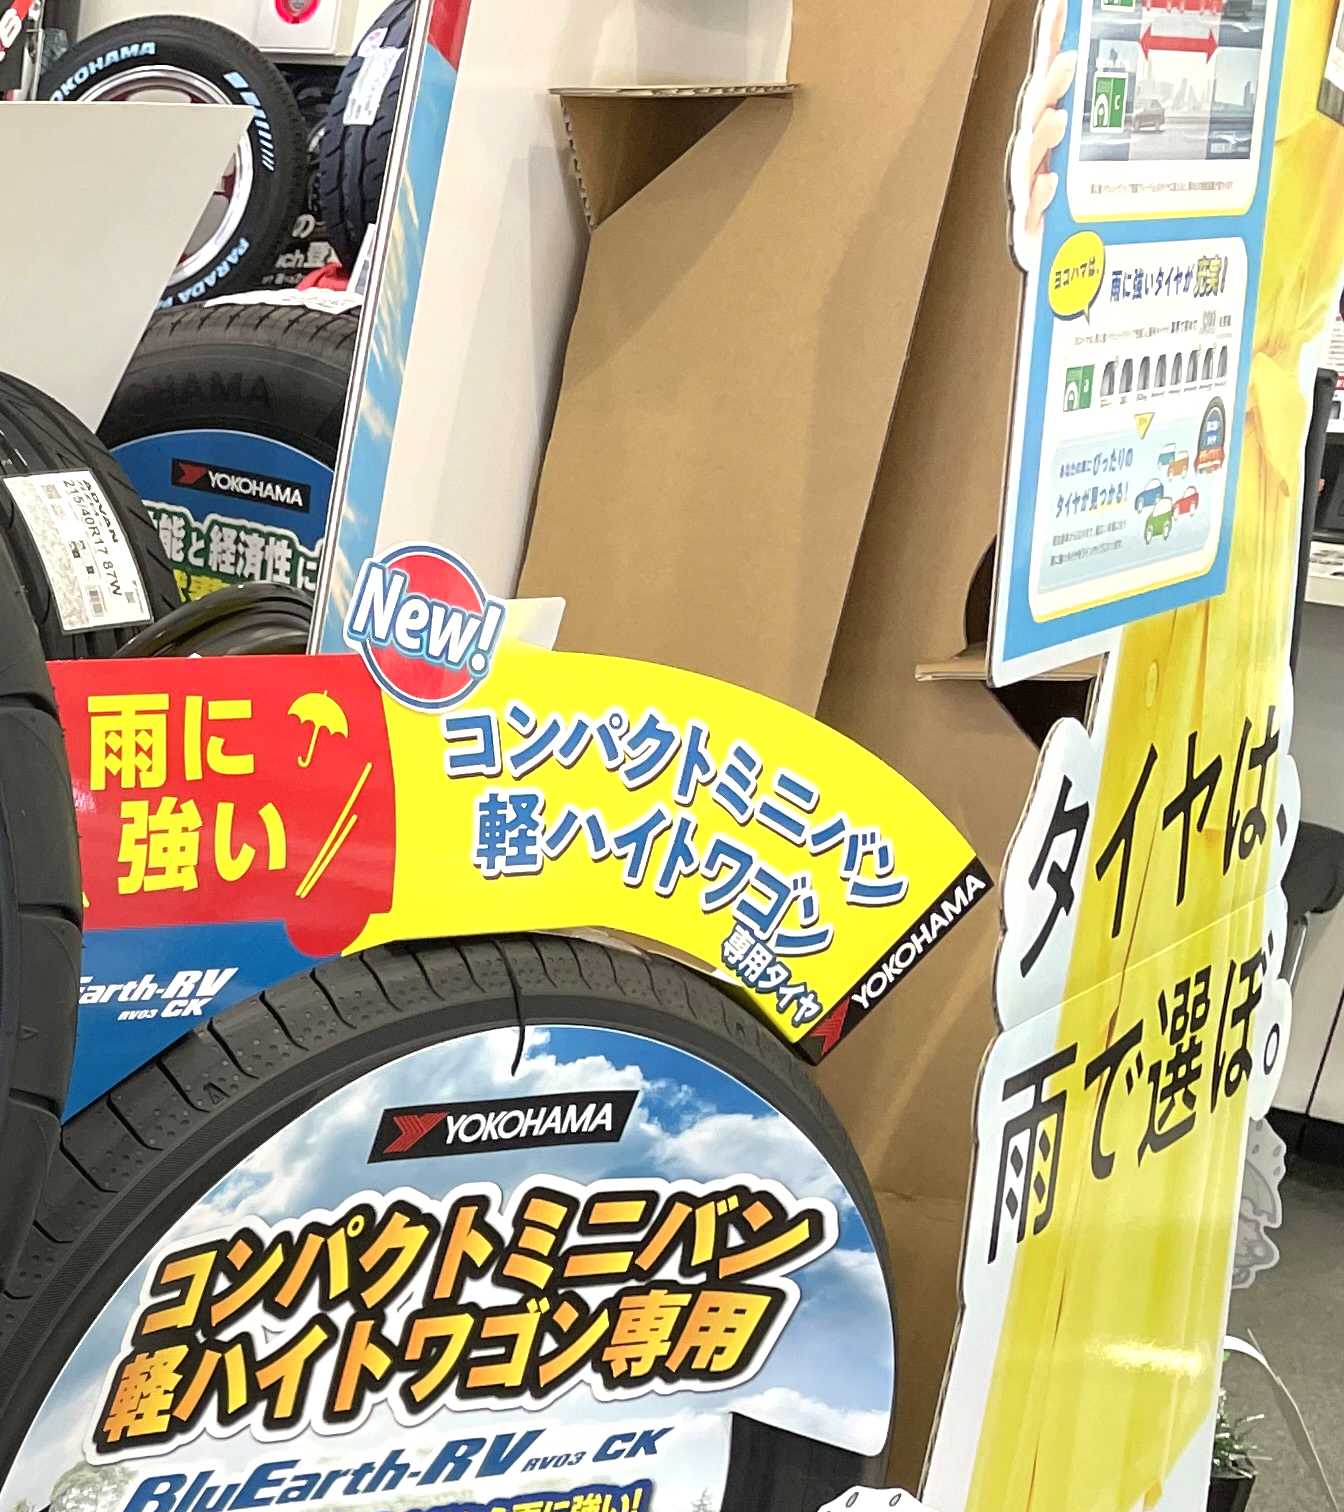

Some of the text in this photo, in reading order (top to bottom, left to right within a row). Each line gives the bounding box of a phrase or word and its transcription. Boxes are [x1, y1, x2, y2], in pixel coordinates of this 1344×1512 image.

[208, 471, 303, 506] YOKOHAMA
[147, 510, 318, 591] 能と経済性に
[357, 568, 502, 676] New!
[87, 692, 255, 791] 雨に
[118, 796, 287, 896] 強い
[444, 706, 907, 905] コンパクトミニバン
[1019, 703, 1288, 979] タイヤは、
[475, 792, 834, 954] 軽ハイトワゴン
[78, 966, 240, 1004] Earth-RV
[161, 998, 211, 1019] CK
[720, 926, 825, 1026] 専用タイヤ
[850, 872, 988, 1011] YOKOHAMA
[443, 1103, 614, 1145] YOKOHAMA
[987, 930, 1283, 1264] 雨で選ぼ。
[140, 1191, 814, 1341] コンパクトミニバン
[105, 1290, 772, 1443] 軽ハイトワゴン専用
[522, 1451, 585, 1474] RV03
[590, 1427, 675, 1464] CK
